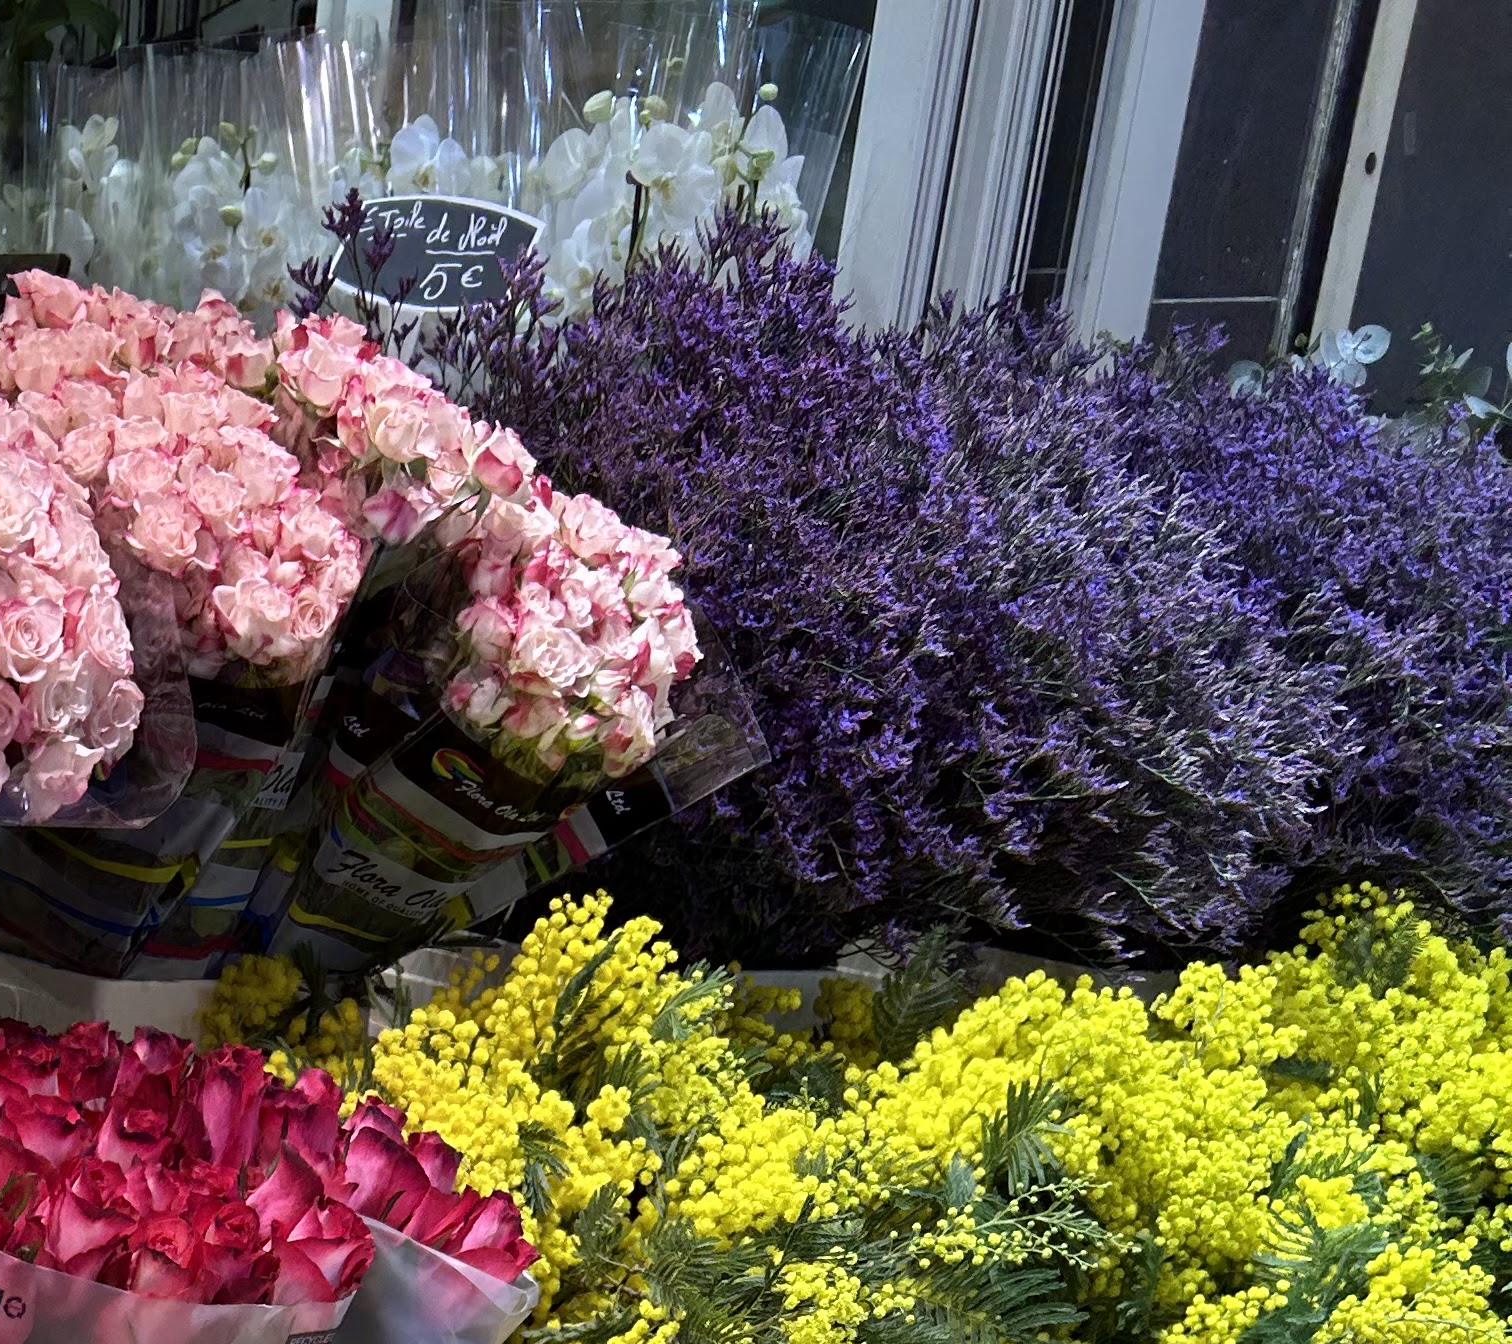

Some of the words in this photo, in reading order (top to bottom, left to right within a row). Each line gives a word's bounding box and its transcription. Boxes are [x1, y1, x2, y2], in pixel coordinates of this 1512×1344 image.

[426, 212, 449, 244] de
[343, 715, 371, 738] Ltd
[455, 780, 493, 809] Flora
[605, 789, 633, 816] Ltd
[327, 850, 398, 898] Flora
[343, 879, 368, 900] HOME
[370, 896, 386, 909] OF
